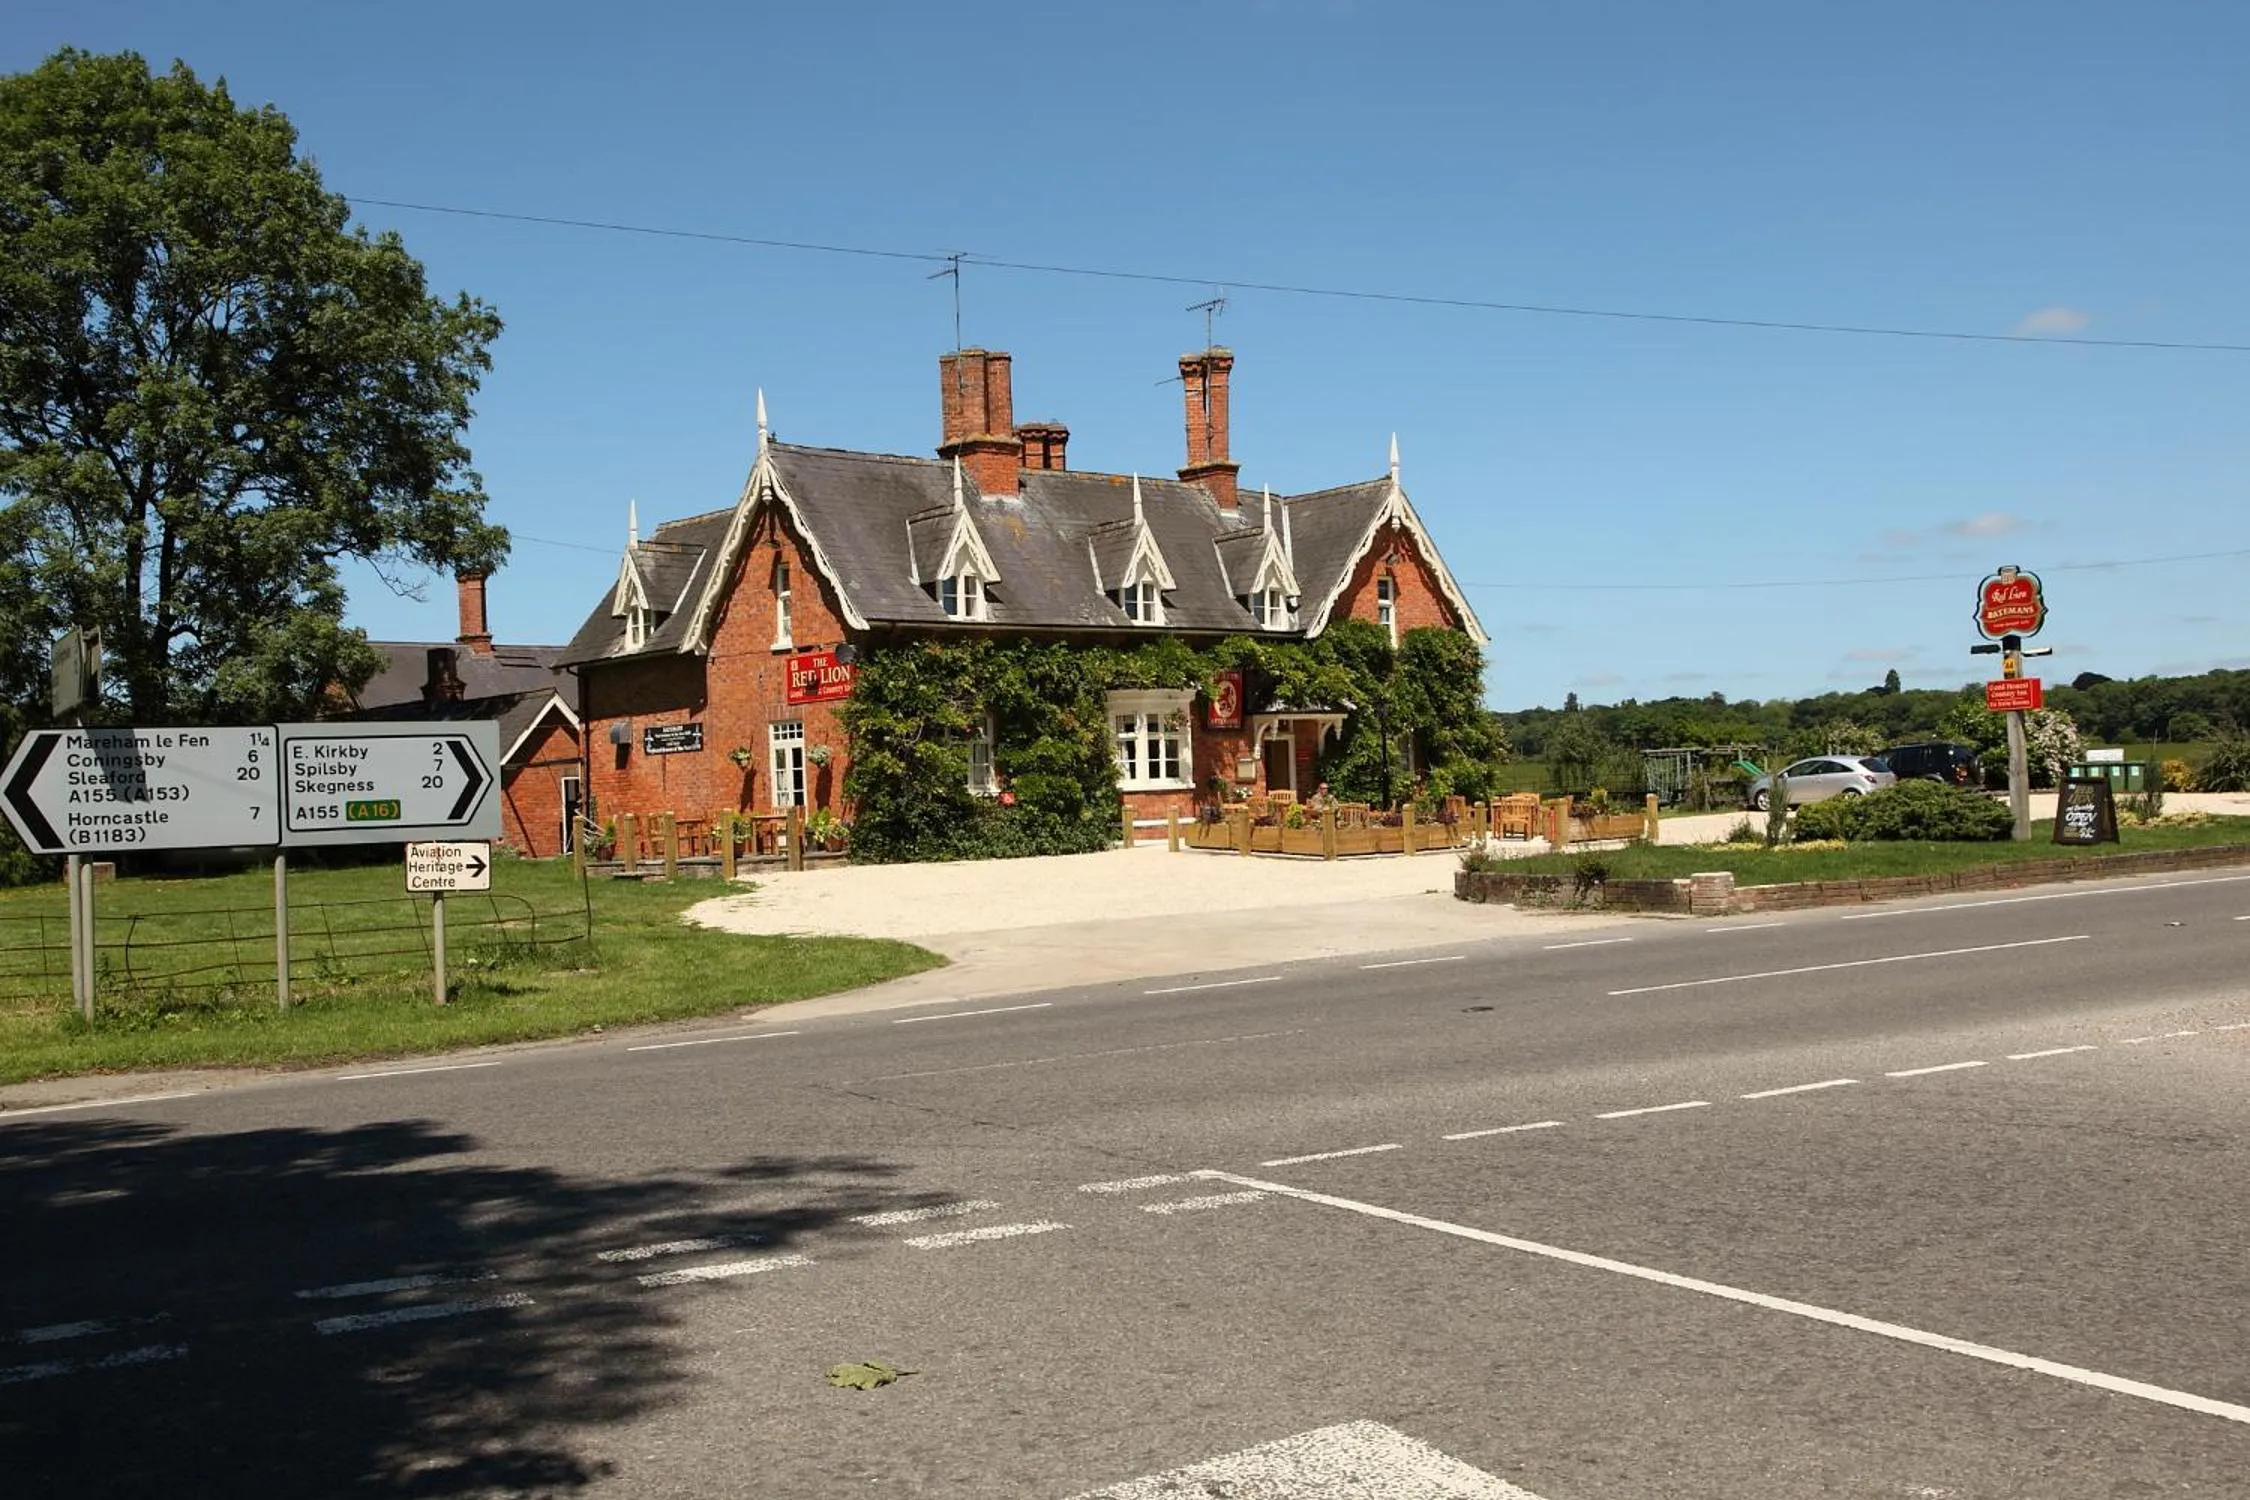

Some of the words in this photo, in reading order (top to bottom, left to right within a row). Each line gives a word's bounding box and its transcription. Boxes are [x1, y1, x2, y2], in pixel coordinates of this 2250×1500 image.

[813, 657, 828, 668] THE
[820, 665, 850, 684] LION
[66, 735, 150, 749] Mareham
[156, 734, 173, 748] le
[179, 733, 210, 747] Fen
[67, 752, 166, 768] Coningsby
[247, 750, 259, 763] 6
[293, 746, 309, 759] E.
[314, 745, 368, 760] Kirkby
[432, 742, 443, 755] 2
[68, 770, 146, 785] Sleaford
[236, 767, 260, 781] 20
[295, 762, 357, 778] Spilsby
[433, 759, 443, 772] 7
[69, 787, 117, 803] A155
[124, 784, 190, 803] (A153)
[295, 780, 375, 794] Skegness
[421, 775, 443, 789] 20
[68, 809, 169, 826] Horncastle
[250, 806, 260, 820] 7
[296, 806, 339, 820] A155
[69, 826, 146, 845] (B1183)
[410, 846, 462, 858] Aviation
[408, 861, 464, 873] Heritage
[412, 876, 456, 889] Centre
